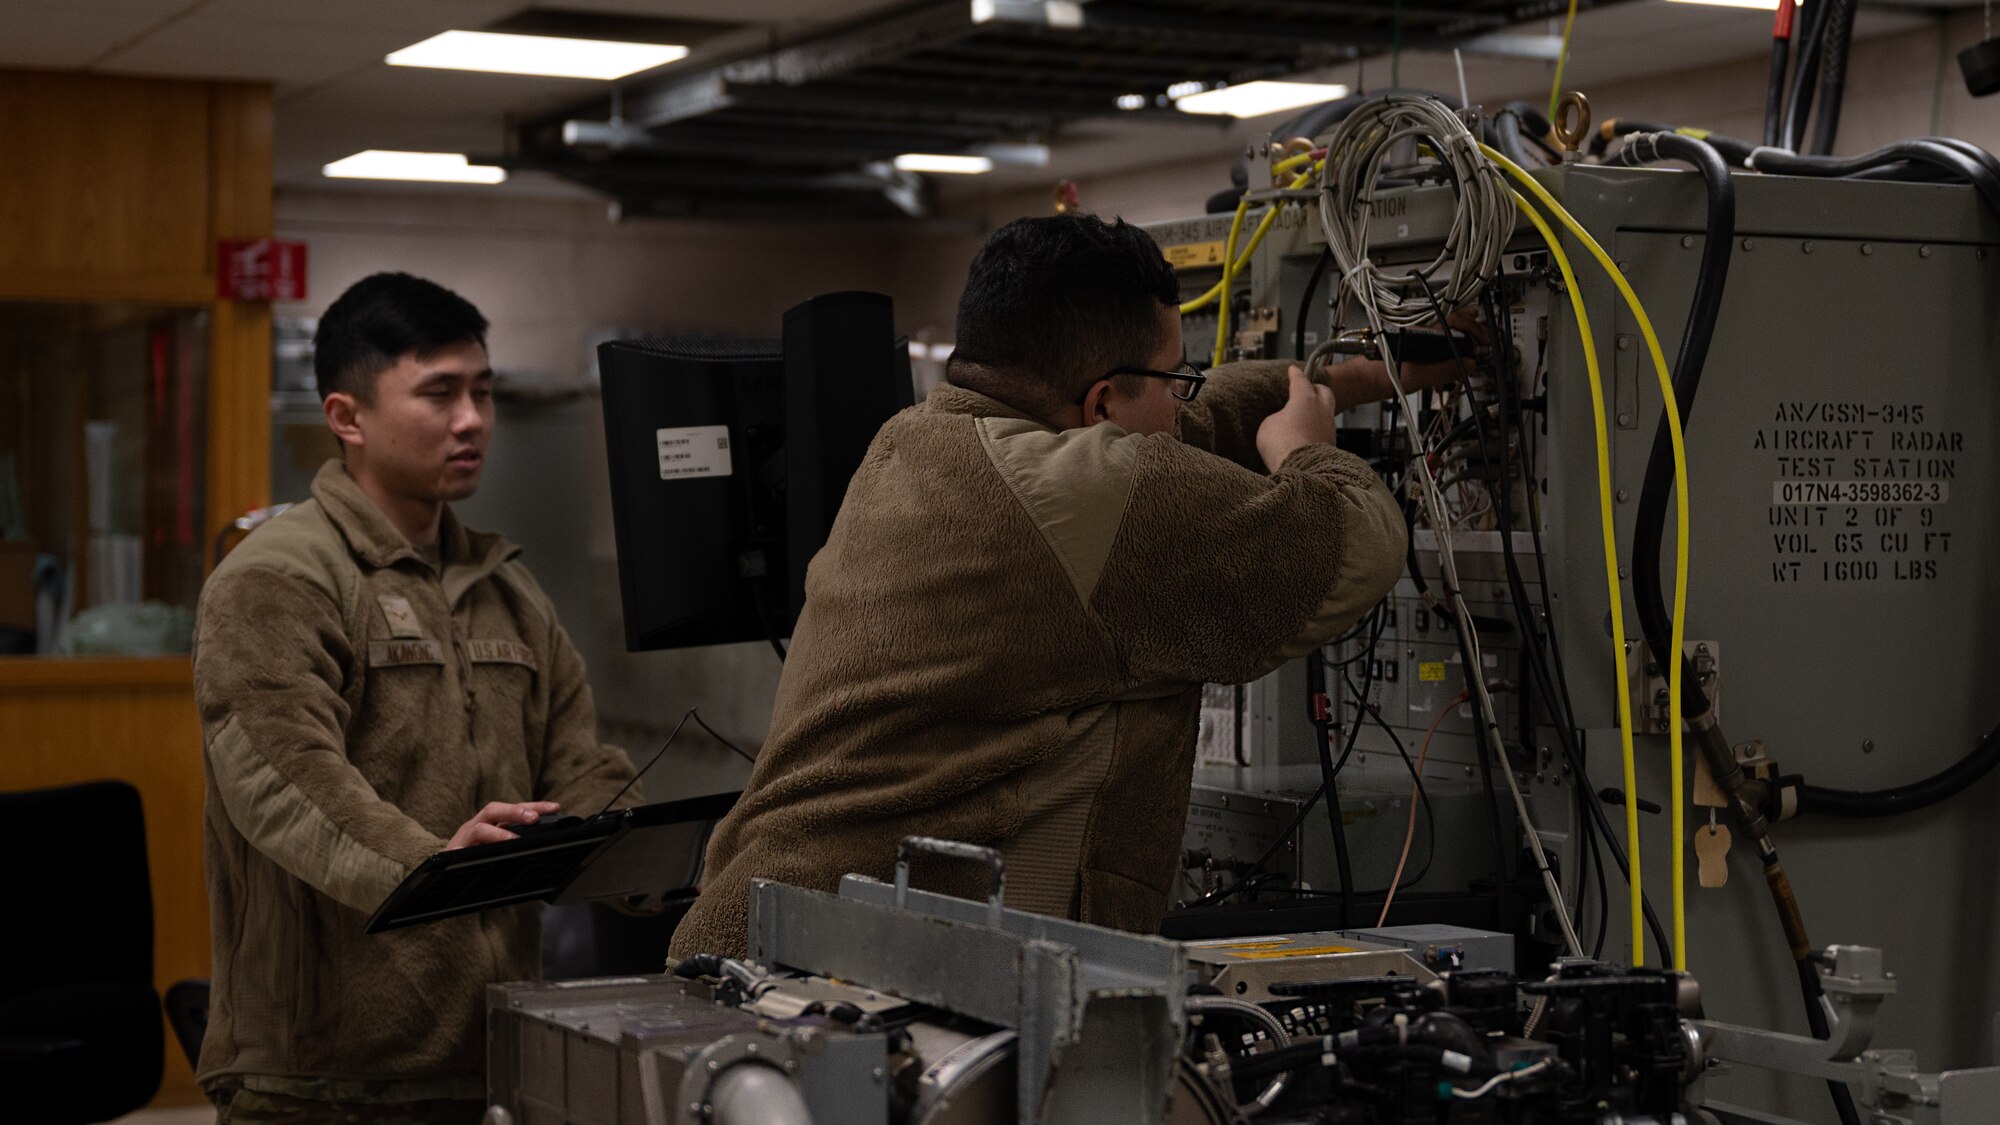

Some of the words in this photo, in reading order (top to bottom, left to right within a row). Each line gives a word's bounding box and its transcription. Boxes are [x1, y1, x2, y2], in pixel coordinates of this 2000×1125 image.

[1206, 214, 1262, 240] AIRCAFT
[1352, 195, 1406, 221] SATION
[1775, 402, 1923, 424] AN/GSM-345
[1754, 429, 1873, 450] AIRCRAFT
[1891, 431, 1963, 451] RADAR
[1777, 456, 1835, 477] TEST
[1854, 458, 1954, 478] STATION
[1783, 483, 1940, 501] 017N4-3598362-3
[1769, 506, 1827, 526] UNIT
[1846, 507, 1858, 526] 2
[1875, 507, 1902, 526] OF
[1920, 507, 1933, 526] 9
[1774, 533, 1817, 553] VOL
[1835, 533, 1863, 553] 65
[1881, 533, 1907, 552] CU
[1925, 532, 1951, 552] FT
[1773, 562, 1801, 582] WT
[1824, 561, 1877, 581] 1600
[1895, 560, 1937, 580] LBS
